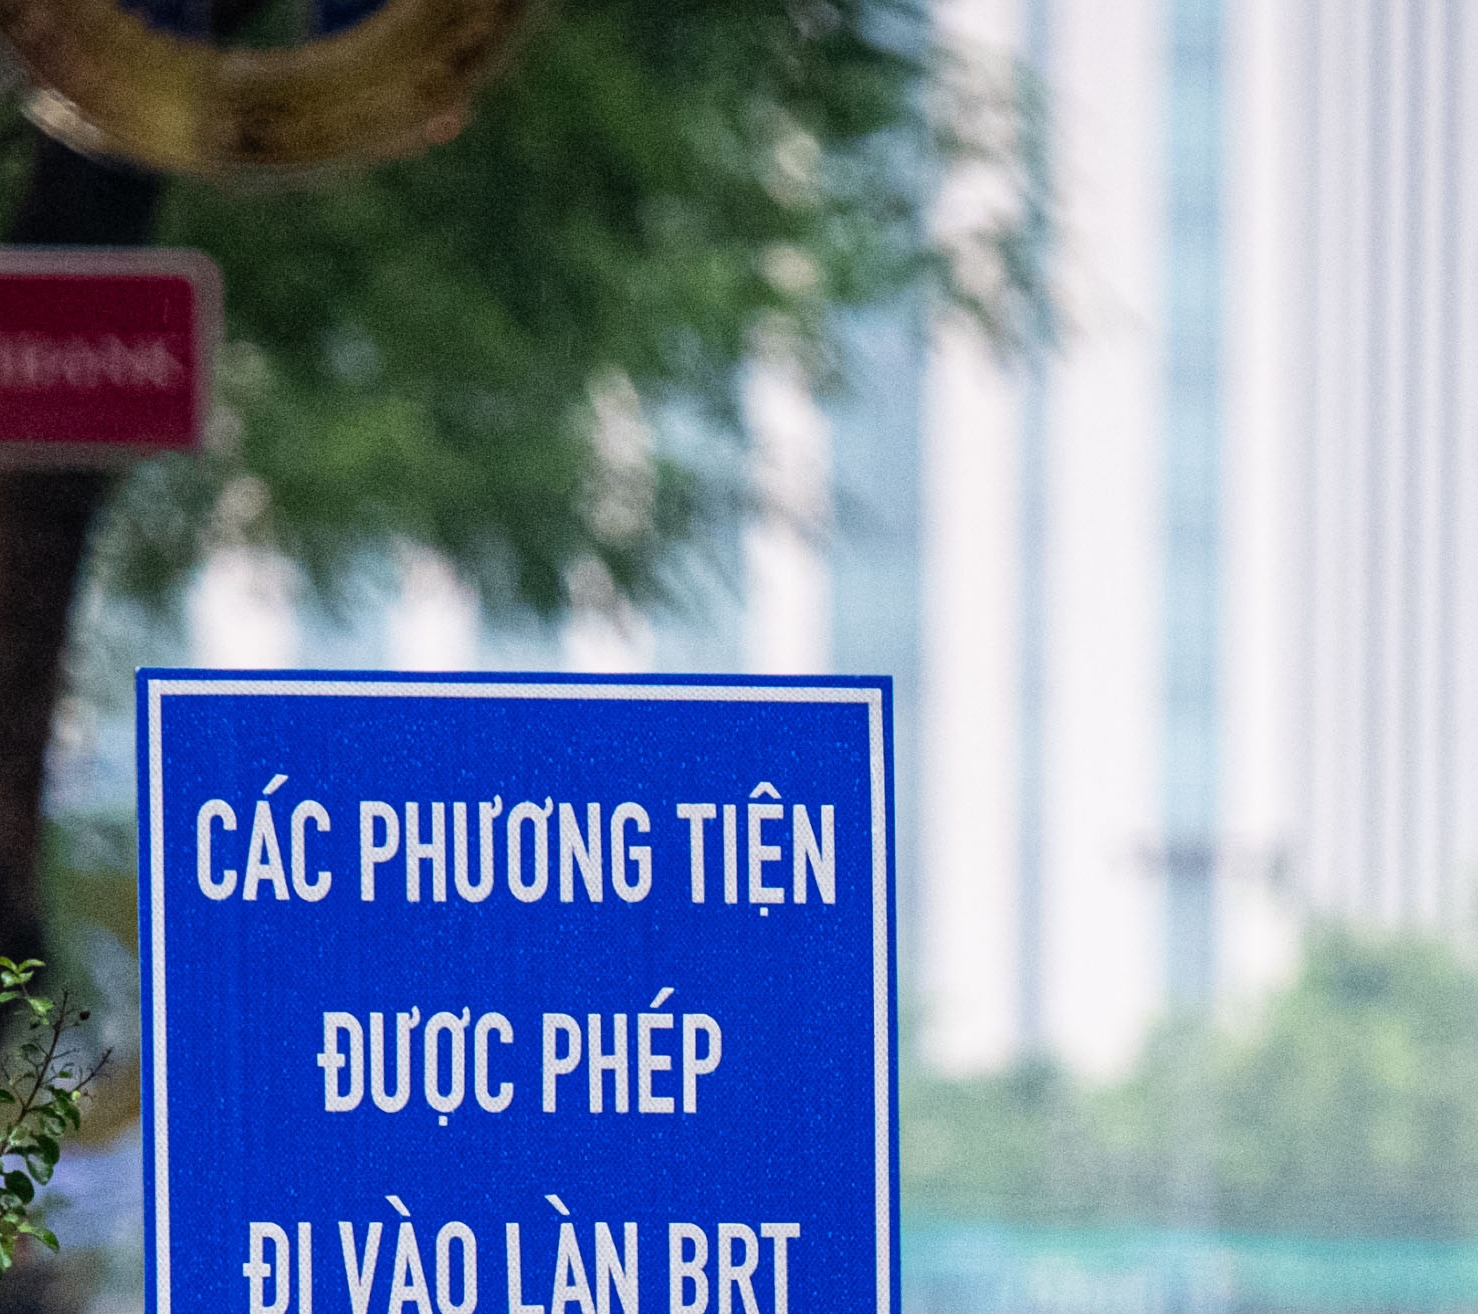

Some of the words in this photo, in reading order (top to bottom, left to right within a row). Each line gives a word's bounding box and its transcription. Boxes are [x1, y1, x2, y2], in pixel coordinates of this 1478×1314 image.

[198, 774, 331, 902] CÁC
[360, 795, 652, 902] PHƯƠNG
[677, 781, 835, 917] TIỆN
[317, 1006, 513, 1127] ĐƯỢC
[543, 988, 722, 1114] PHÉP
